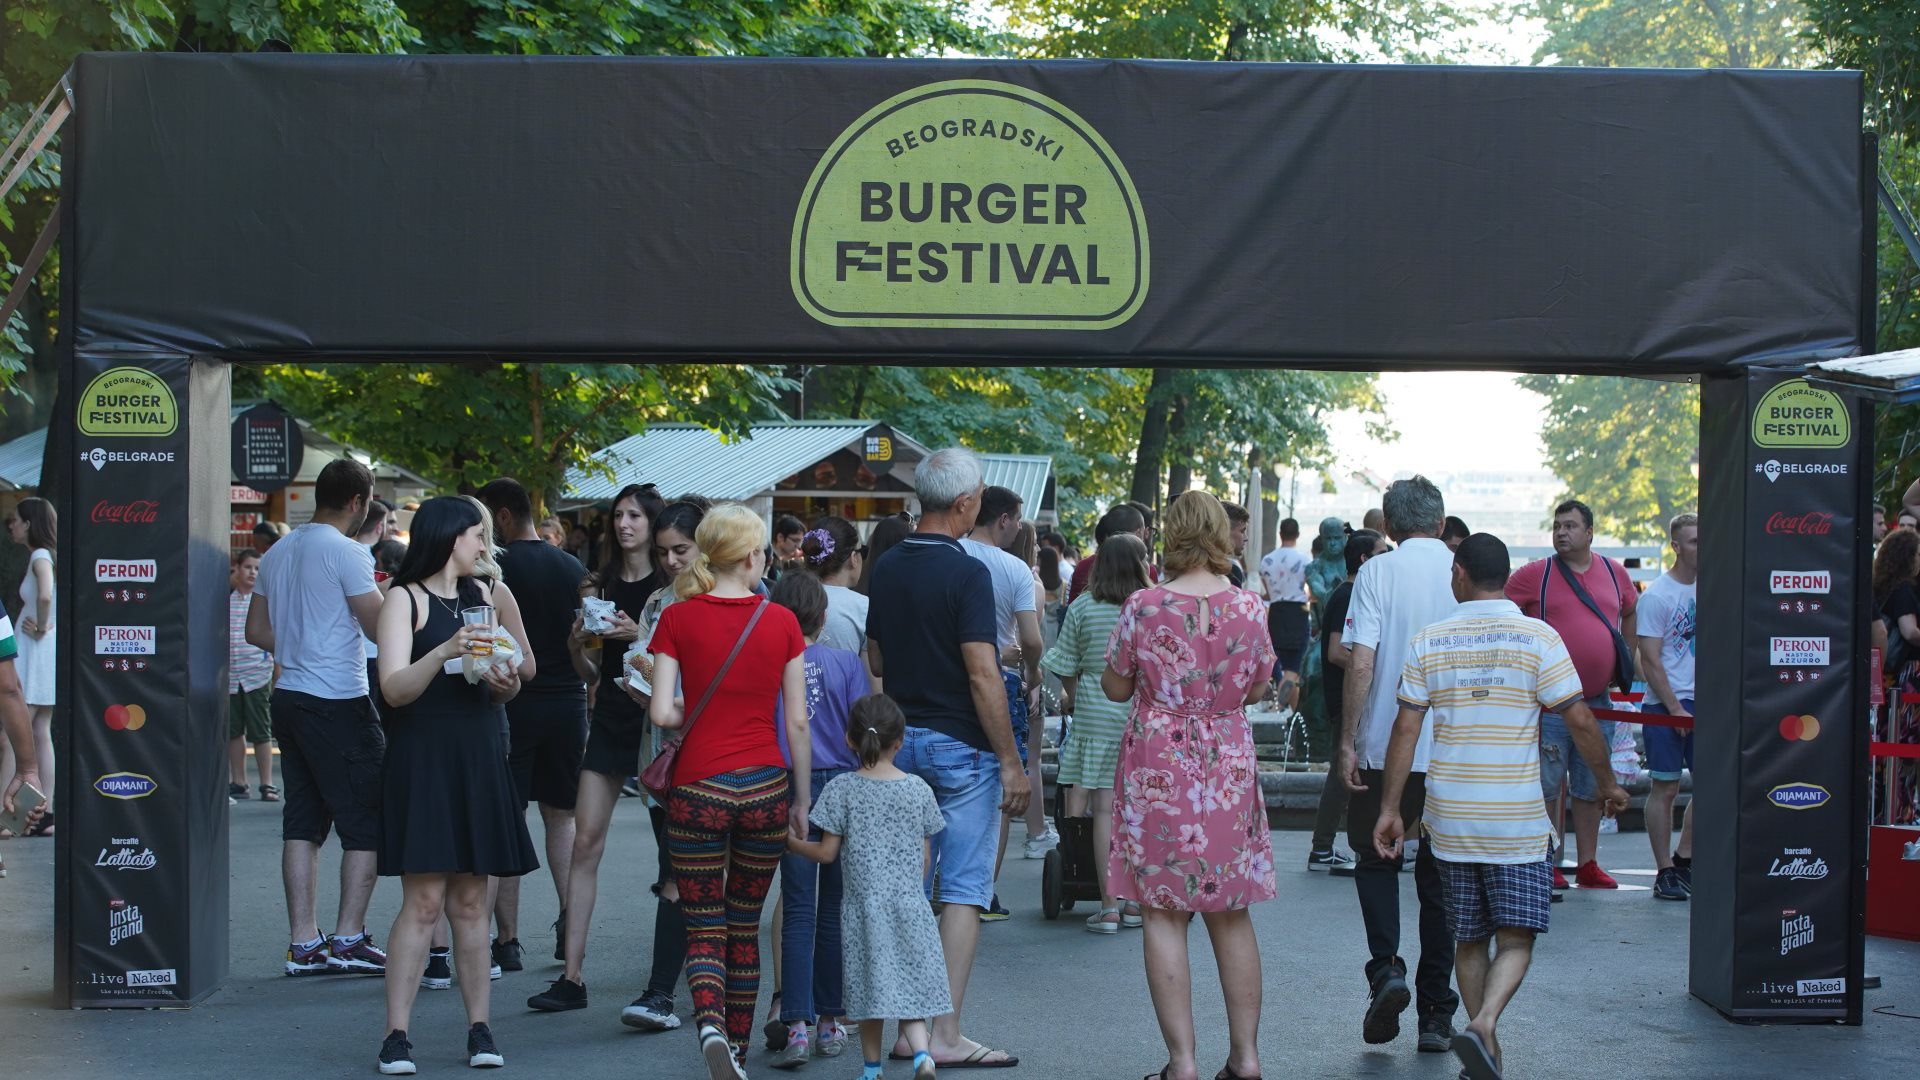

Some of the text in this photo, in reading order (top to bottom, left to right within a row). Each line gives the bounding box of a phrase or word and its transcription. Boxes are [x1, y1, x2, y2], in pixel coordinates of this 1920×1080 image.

[885, 118, 1064, 161] BEOGRADSKI
[861, 182, 1087, 225] BURGER
[836, 241, 1110, 285] FESTIVAL
[103, 377, 154, 389] BEOGRADSKI
[96, 395, 160, 407] BURGER
[1778, 389, 1827, 401] BEOGRADSKI
[89, 412, 167, 424] FESTIVAL
[1770, 407, 1833, 419] BURGER
[1764, 424, 1840, 436] FESTIVAL
[98, 564, 154, 577] PERONI
[1773, 576, 1828, 589] PERONI
[98, 627, 153, 640] PERONI
[1773, 639, 1825, 651] PERONI
[102, 781, 149, 792] DIJAMANT
[1776, 791, 1822, 802] DIJAMANT
[110, 905, 139, 928] Insta
[110, 915, 143, 946] grand
[1781, 914, 1810, 937] Insta
[1781, 924, 1814, 956] grand
[132, 972, 171, 984] Naked
[1802, 981, 1841, 993] Naked
[1783, 998, 1806, 1006] spirit
